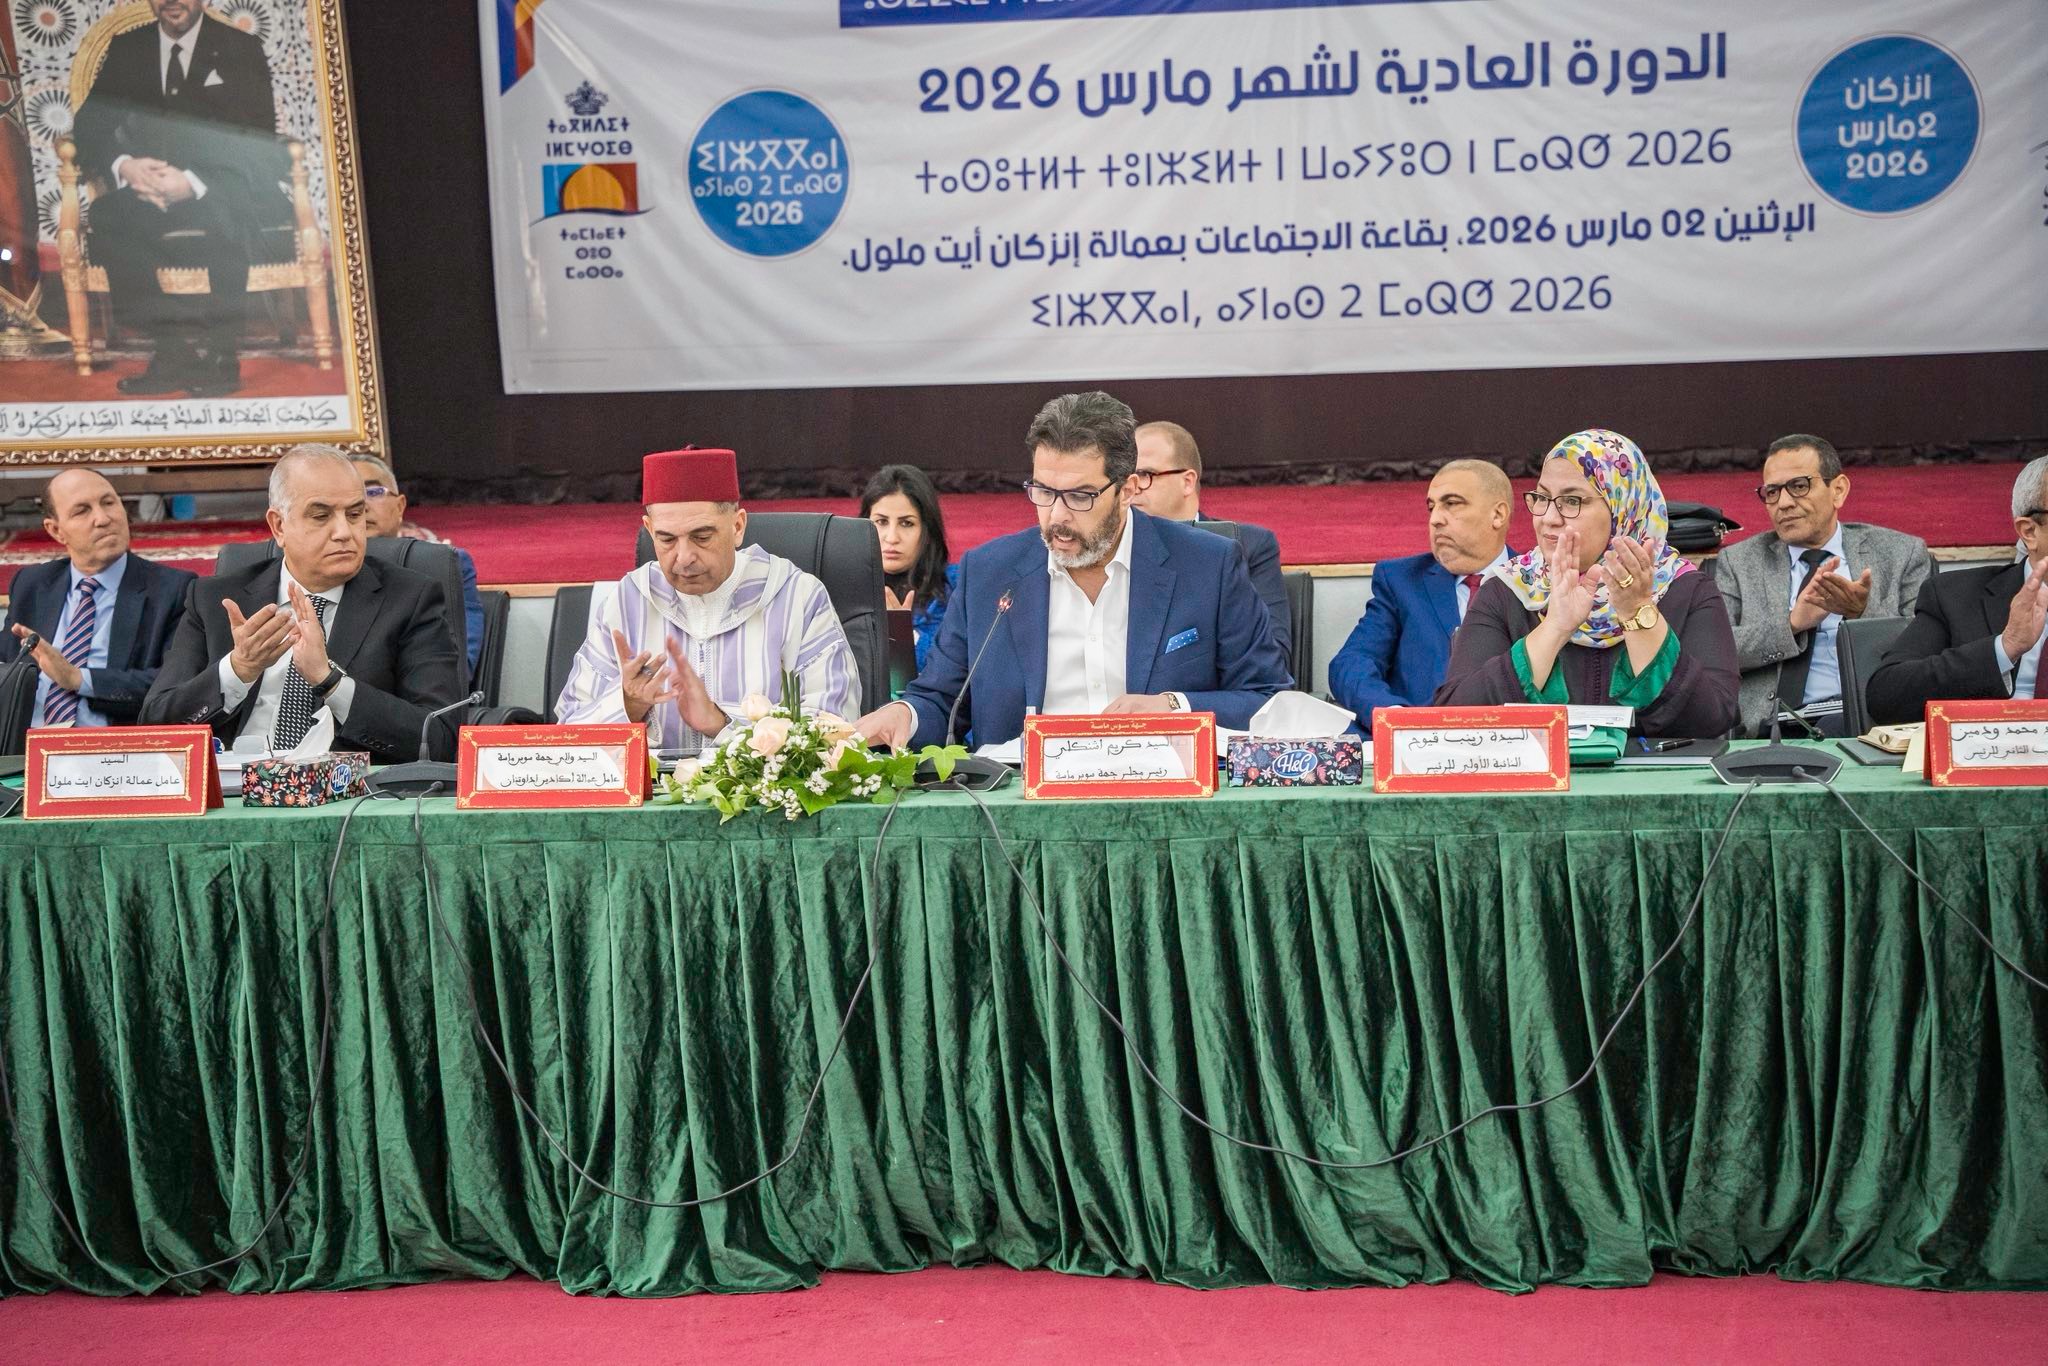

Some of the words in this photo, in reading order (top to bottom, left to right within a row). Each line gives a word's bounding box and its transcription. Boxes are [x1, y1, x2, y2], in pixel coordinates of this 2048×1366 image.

[1227, 43, 1359, 113] لشهر
[1376, 41, 1550, 105] العادية
[1567, 32, 1727, 96] الدورة
[919, 63, 1061, 112] 2026
[1077, 58, 1211, 118] مارس
[1845, 74, 1931, 110] انزكان
[1626, 128, 1732, 168] 2026
[1846, 149, 1929, 179] 2026
[759, 174, 773, 196] 2
[736, 200, 804, 227] 2026
[1662, 208, 1706, 238] 02
[1715, 200, 1815, 242] الإثنين
[1196, 221, 1352, 258] الاجتماعات
[1361, 218, 1448, 252] بقاعة
[1566, 211, 1652, 248] مارس
[934, 226, 982, 270] أيت
[990, 230, 1081, 268] إنزكان
[1089, 229, 1187, 261] بعمالة
[1340, 284, 1363, 318] 2
[1509, 275, 1613, 312] 2026
[1443, 730, 1484, 747] زينب
[1490, 728, 1529, 744] السيدة
[2006, 725, 2038, 736] محمد
[100, 754, 129, 766] السيد
[577, 752, 598, 763] السيد
[1107, 739, 1142, 755] كريم
[1277, 753, 1312, 778] H&G
[49, 775, 72, 789] ملول
[75, 776, 92, 787] ايت
[95, 775, 123, 789] انزكان
[126, 776, 153, 787] عمالة
[155, 776, 180, 787] عامل
